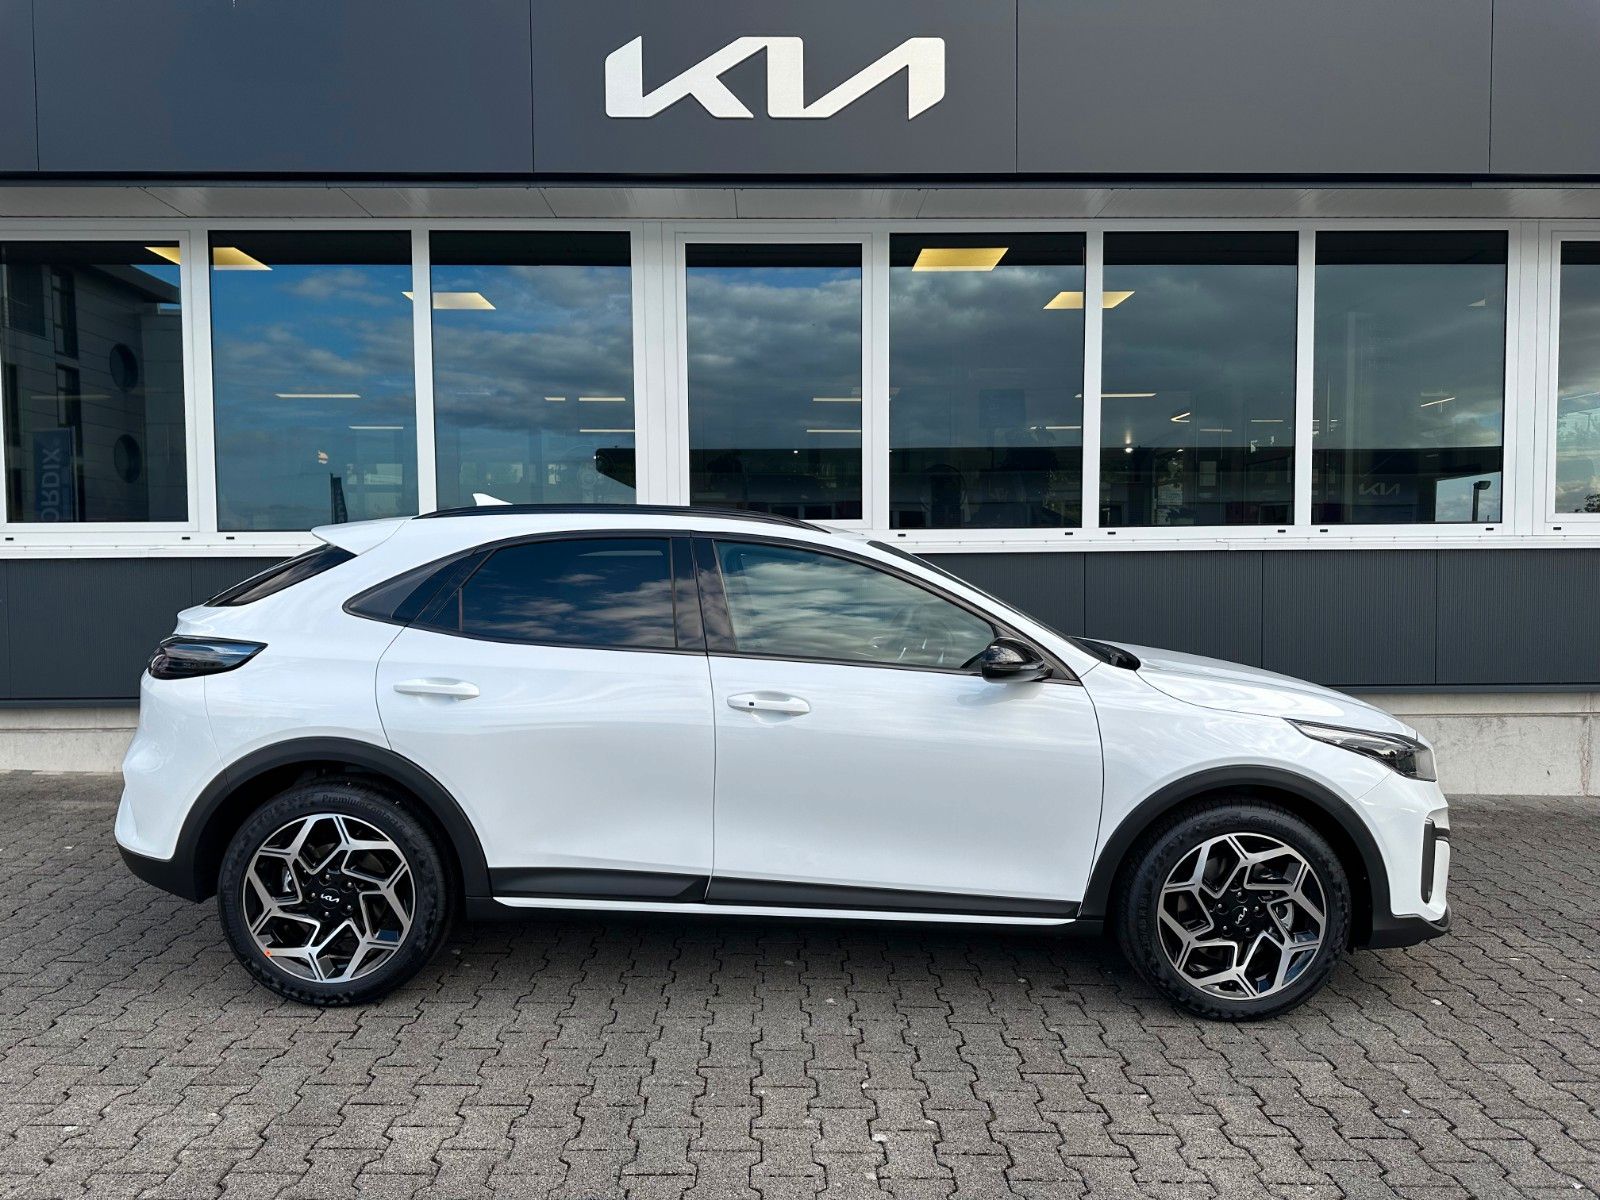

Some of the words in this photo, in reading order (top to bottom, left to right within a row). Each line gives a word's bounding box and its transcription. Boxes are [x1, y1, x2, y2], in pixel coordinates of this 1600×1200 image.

[605, 36, 946, 121] KIA
[1359, 483, 1400, 496] KIA
[320, 893, 340, 903] KIA
